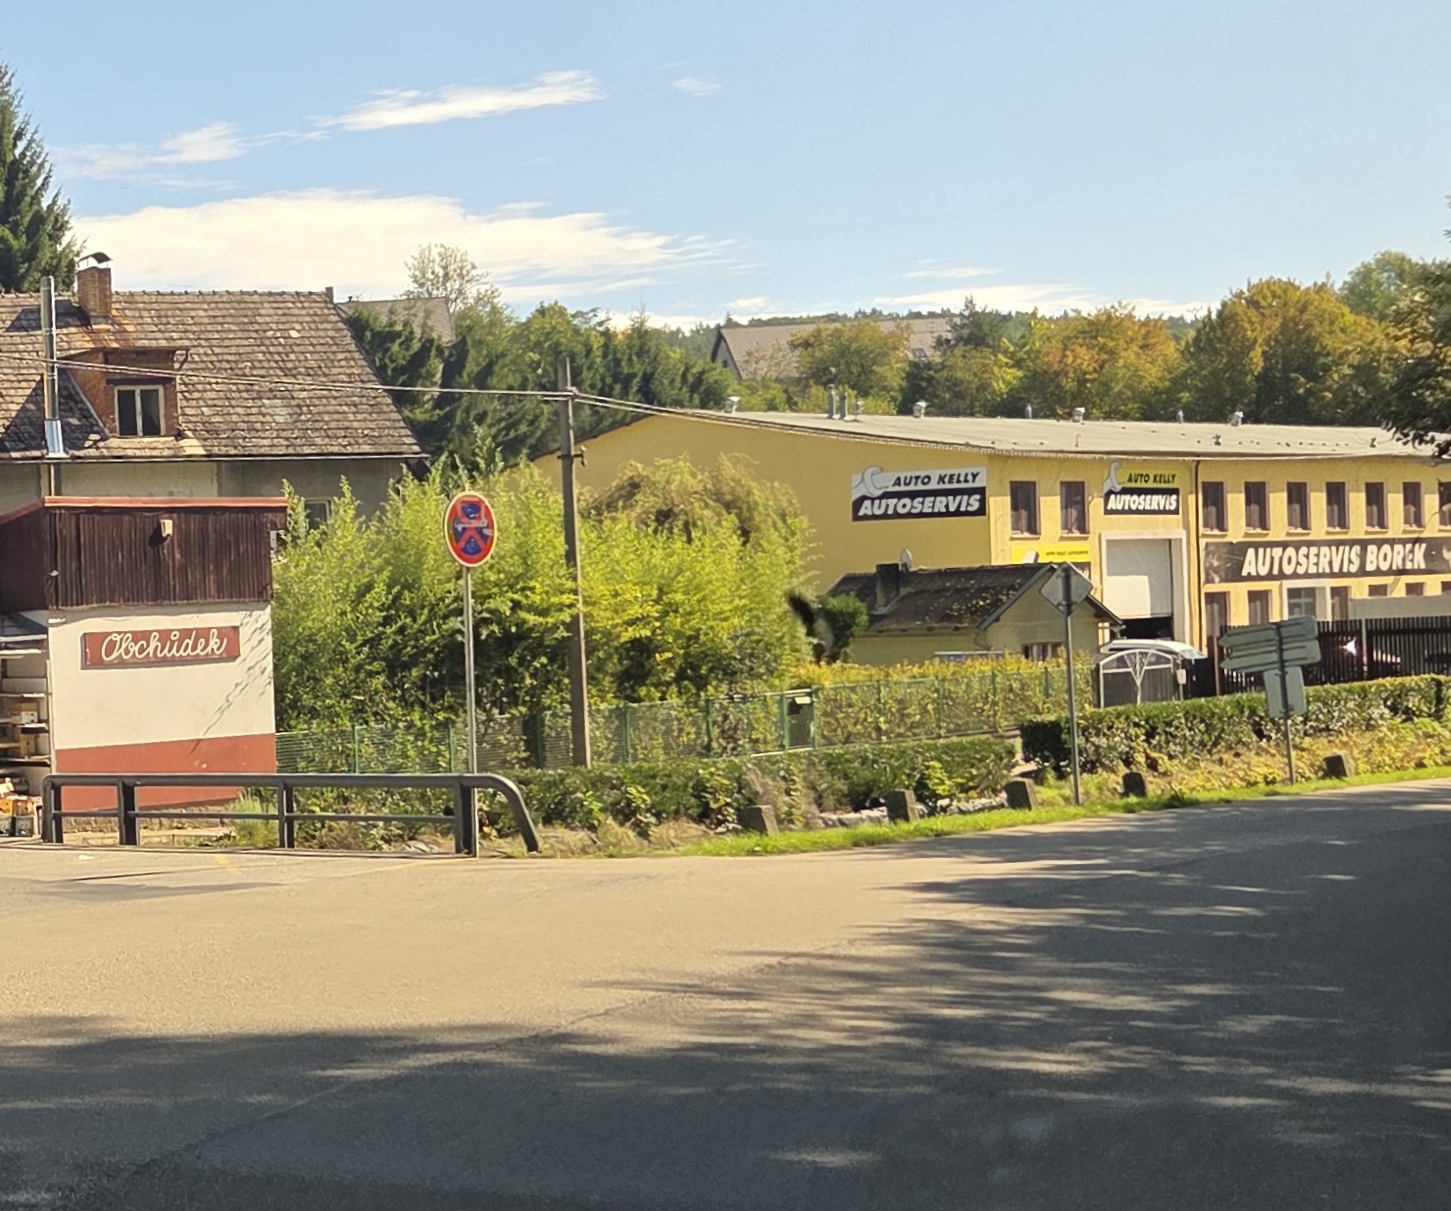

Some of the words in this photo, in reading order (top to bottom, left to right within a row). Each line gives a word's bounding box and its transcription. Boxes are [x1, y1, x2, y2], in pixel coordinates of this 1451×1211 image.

[891, 475, 932, 488] AUTO
[936, 471, 980, 486] KELLY
[1126, 472, 1151, 484] AUTO
[1152, 473, 1176, 484] KELLY
[857, 494, 981, 516] AUTOSERVIS
[1106, 493, 1178, 511] AUTOSERVIS
[1241, 545, 1361, 577] AUTOSERVIS
[1365, 542, 1427, 572] BOREK
[101, 628, 228, 662] Obchůdek
